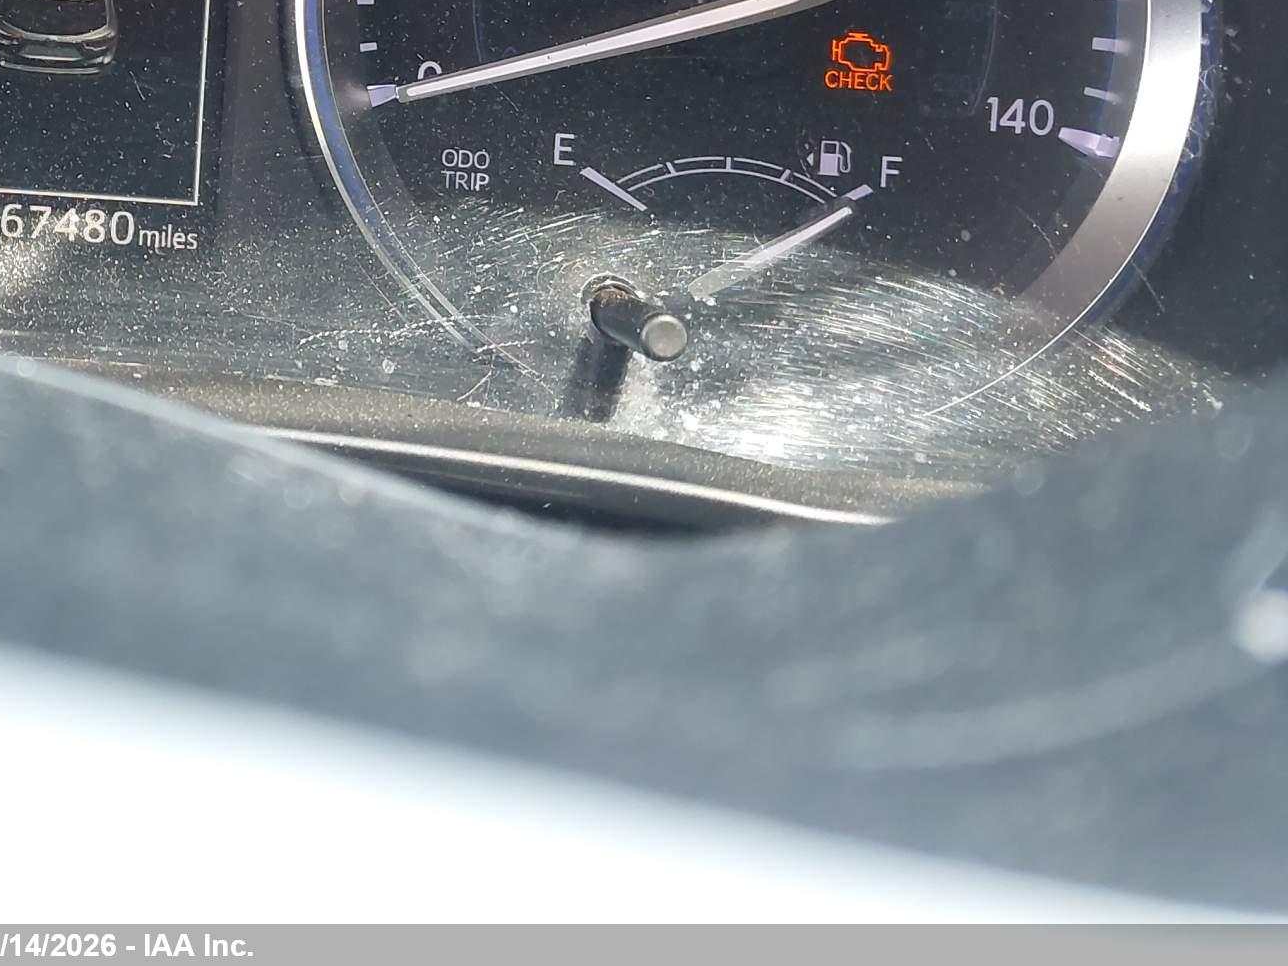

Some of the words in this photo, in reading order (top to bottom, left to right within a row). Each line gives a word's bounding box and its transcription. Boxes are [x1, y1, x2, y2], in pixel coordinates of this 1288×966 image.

[824, 67, 892, 91] CHECK
[986, 96, 1054, 136] 140
[442, 148, 490, 170] ODO
[553, 132, 577, 166] E
[440, 170, 490, 192] TRIP
[880, 155, 903, 188] F
[138, 223, 198, 251] miles
